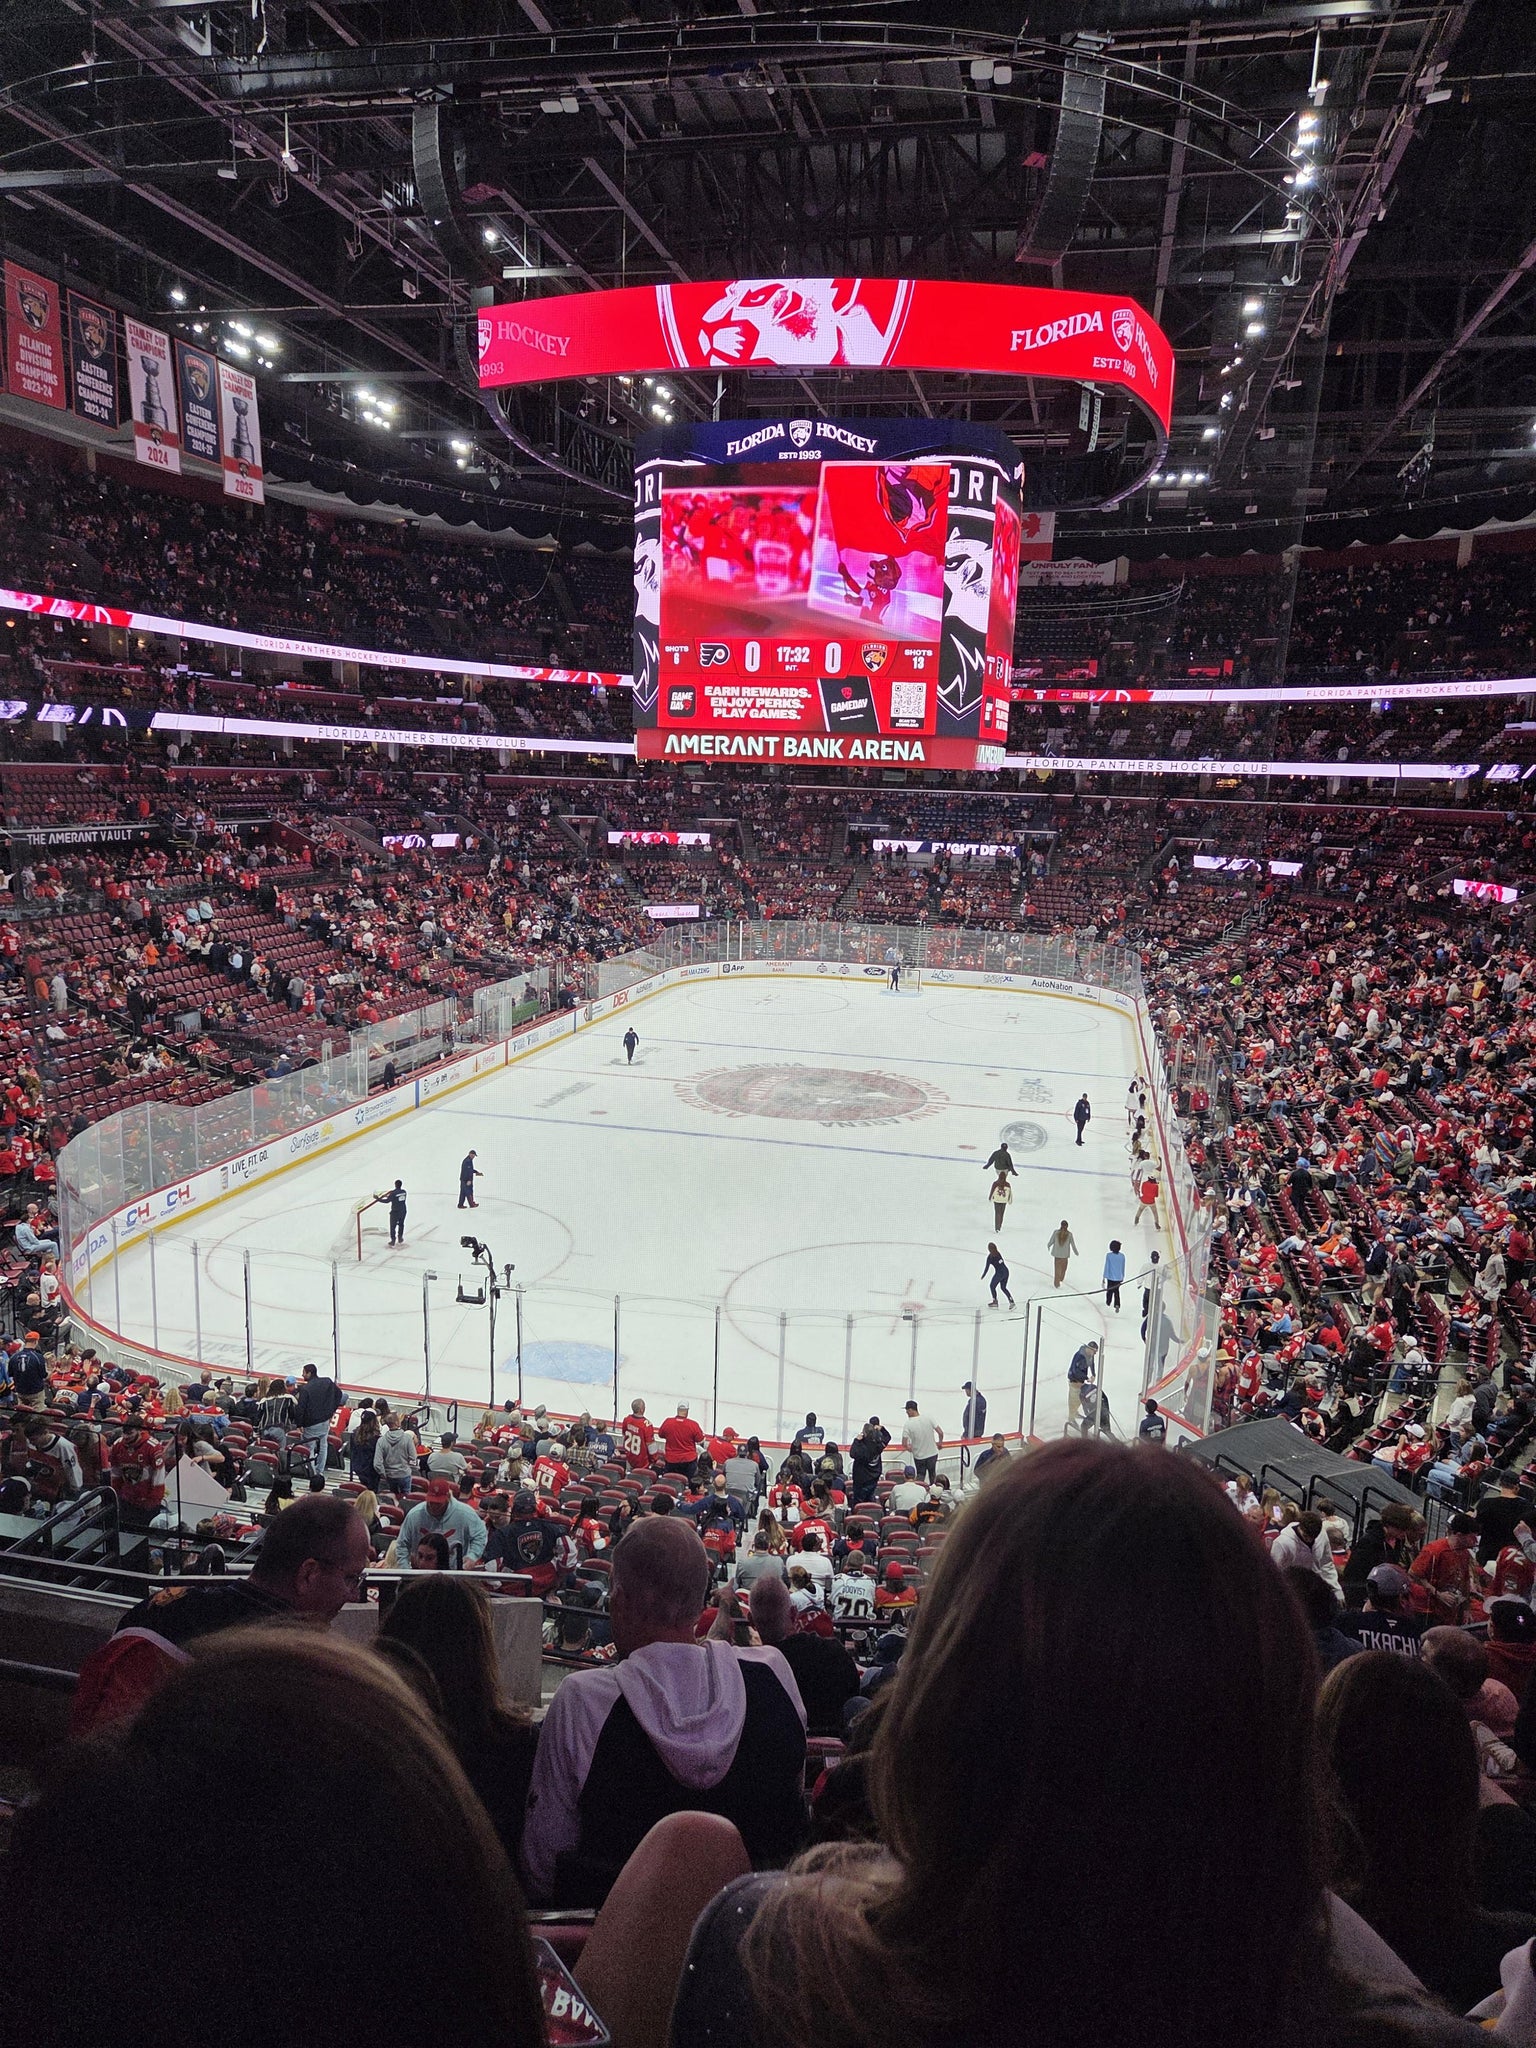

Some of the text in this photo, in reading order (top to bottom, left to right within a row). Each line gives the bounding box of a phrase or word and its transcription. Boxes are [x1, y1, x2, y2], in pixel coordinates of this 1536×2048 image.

[496, 320, 570, 356] HOCKEY
[1010, 311, 1104, 351] FLORIDA
[19, 333, 52, 357] ATLANTIC
[20, 347, 52, 370] DIVISION
[15, 361, 58, 386] CHAMPIONS
[81, 359, 108, 381] EASTERN
[479, 361, 504, 378] 1993
[22, 377, 53, 398] 2023-24
[726, 422, 878, 456] FLORIDA HOCKEY
[148, 446, 168, 465] 2024
[798, 450, 821, 459] 1993
[235, 479, 253, 496] 2025
[255, 638, 407, 664] FLORIDA PANTHERS HOCKEY CLUB
[745, 641, 760, 672] 0
[776, 646, 810, 663] 17:32
[825, 642, 841, 674] 0
[904, 649, 933, 657] SHOTS
[671, 692, 693, 701] GAME
[704, 686, 812, 698] EARN REWARDS.
[1306, 684, 1493, 697] FLORIDA PANTHERS HOCKEY CLUB
[710, 697, 804, 709] ENJOY PERKS.
[713, 708, 801, 719] PLAY GAMES.
[830, 698, 868, 713] GAMEDAY
[318, 727, 526, 748] FLORIDA PANTHERS HOCKEY CLUB
[664, 734, 925, 761] AMERANT BANK ARENA
[1025, 758, 1269, 773] FLORIDA PANTHERS HOCKEY CLUB
[27, 830, 132, 845] THE AMERANT VAULT
[1031, 979, 1073, 991] AutoNation
[613, 990, 629, 1008] DEX
[290, 1129, 319, 1153] Surfside
[232, 1150, 269, 1174] LIVE. FIT. GO.
[72, 1234, 108, 1273] HODA
[624, 1430, 641, 1456] 28
[535, 1470, 554, 1489] 19
[838, 1596, 868, 1617] 70
